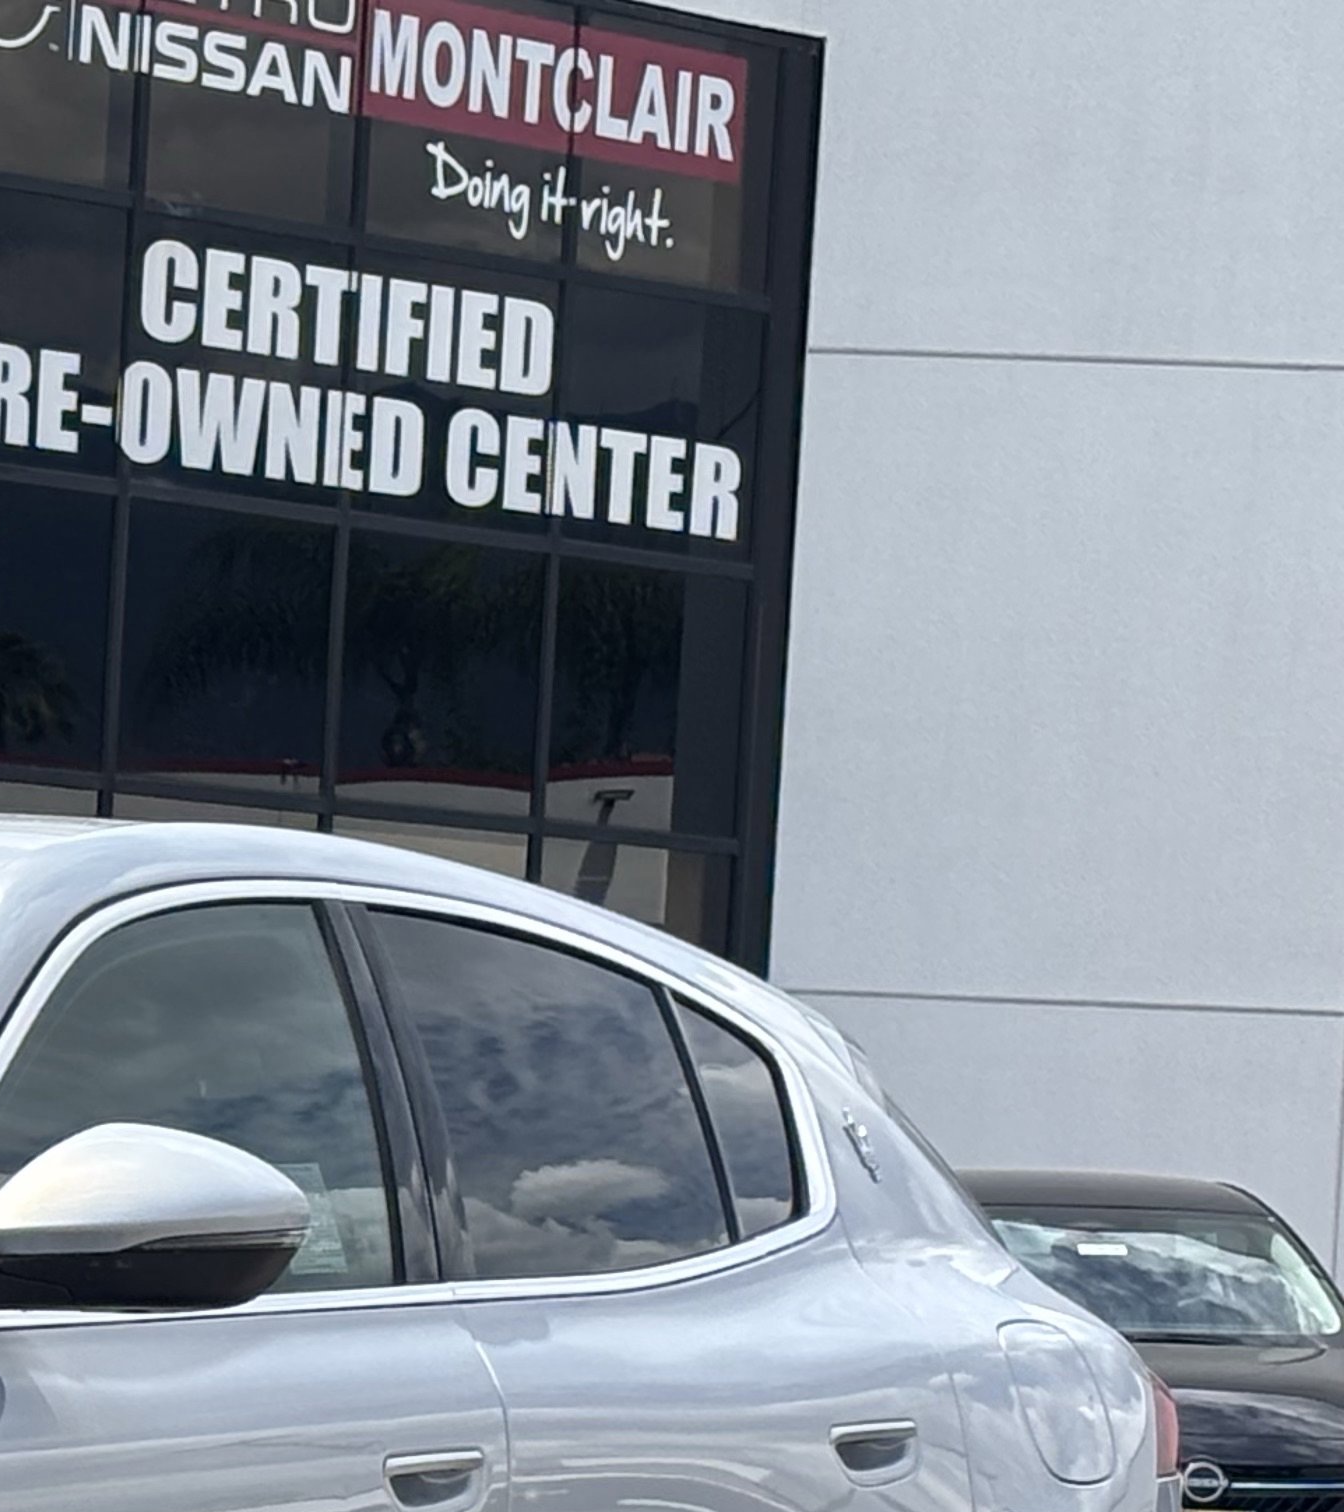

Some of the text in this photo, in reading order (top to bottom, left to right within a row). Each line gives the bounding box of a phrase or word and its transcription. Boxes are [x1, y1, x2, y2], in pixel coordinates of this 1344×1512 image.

[78, 4, 353, 114] NISSAN
[369, 8, 736, 163] MONTCLAIR
[426, 141, 675, 261] Doing it right.
[140, 239, 556, 397] CERTIFIED
[446, 406, 742, 541] CENTER
